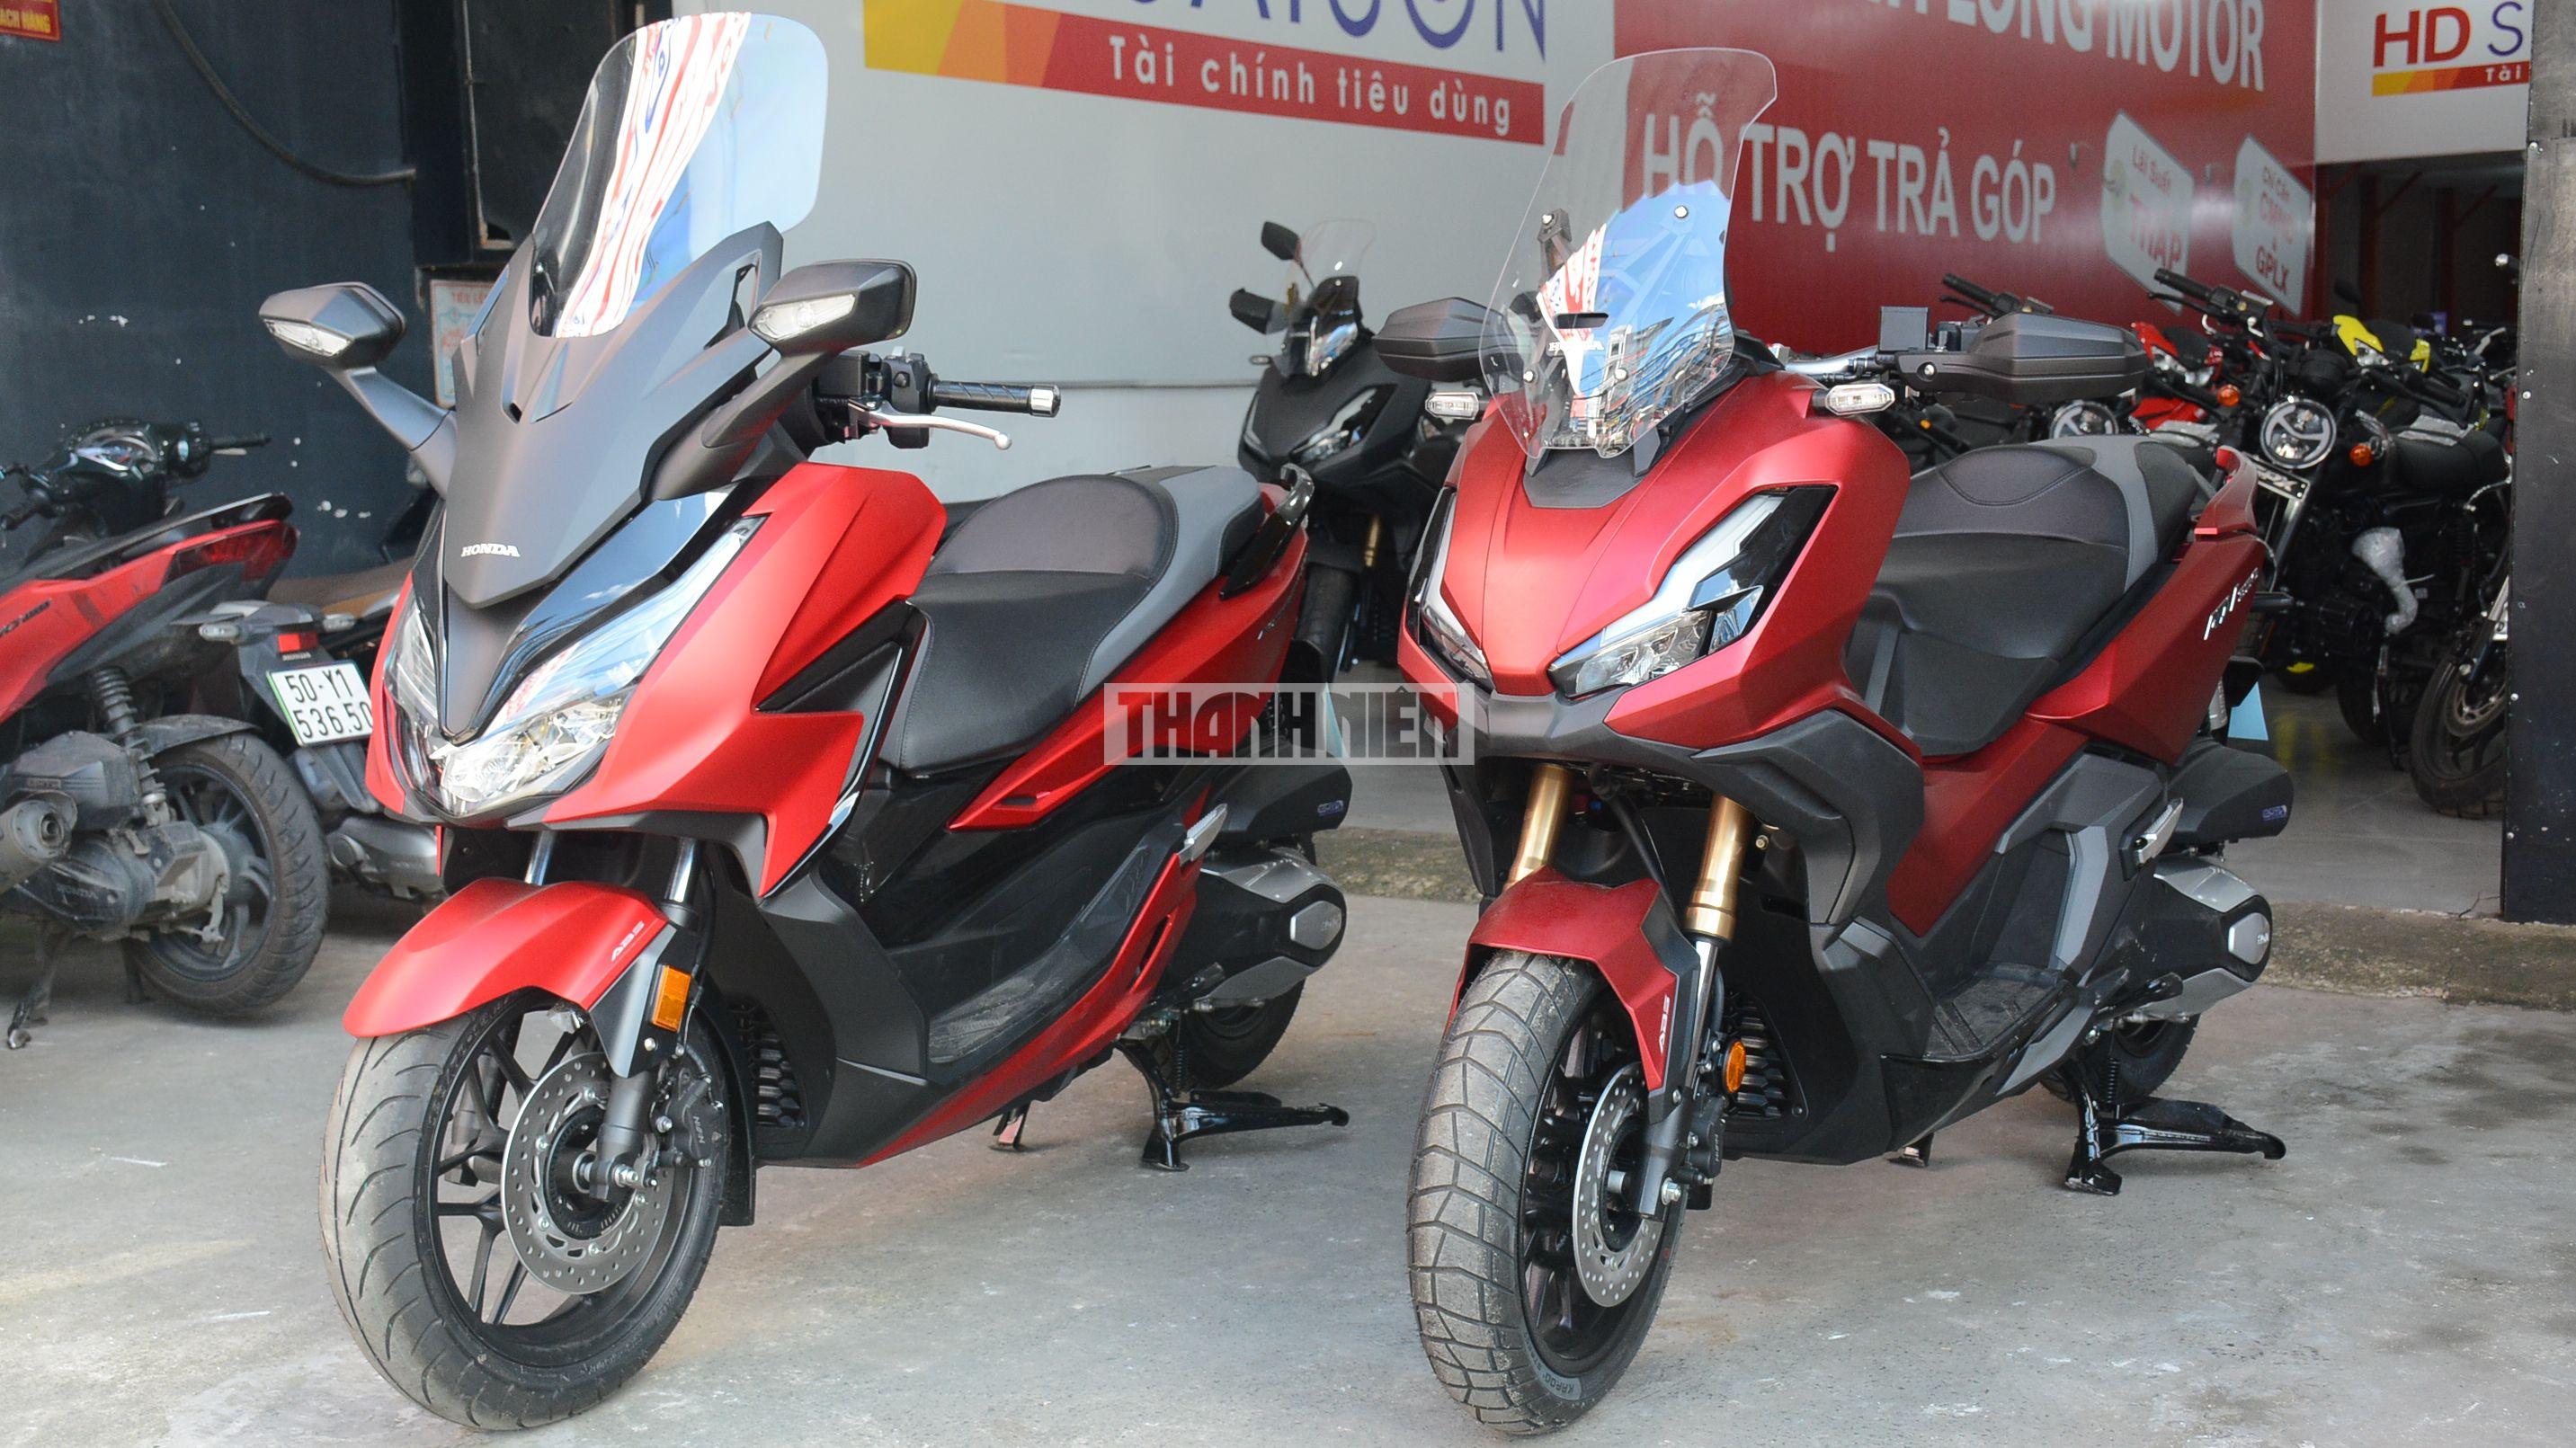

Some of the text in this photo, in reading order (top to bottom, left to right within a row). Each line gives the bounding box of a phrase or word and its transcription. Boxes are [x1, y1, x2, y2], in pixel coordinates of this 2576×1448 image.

[2107, 0, 2264, 91] MOTOR
[2373, 7, 2471, 67] HD
[1109, 33, 1511, 136] Tài chính tiêu dùng
[2485, 64, 2521, 83] Tài
[1739, 122, 1857, 253] TRỢ
[1867, 126, 1959, 238] TRẢ
[1970, 138, 2056, 244] GÓP
[2256, 244, 2289, 294] GPLX
[460, 543, 521, 557] HONDA
[284, 668, 353, 704] 50-Y1
[611, 920, 645, 962] ABS
[1658, 993, 1671, 1055] ABS
